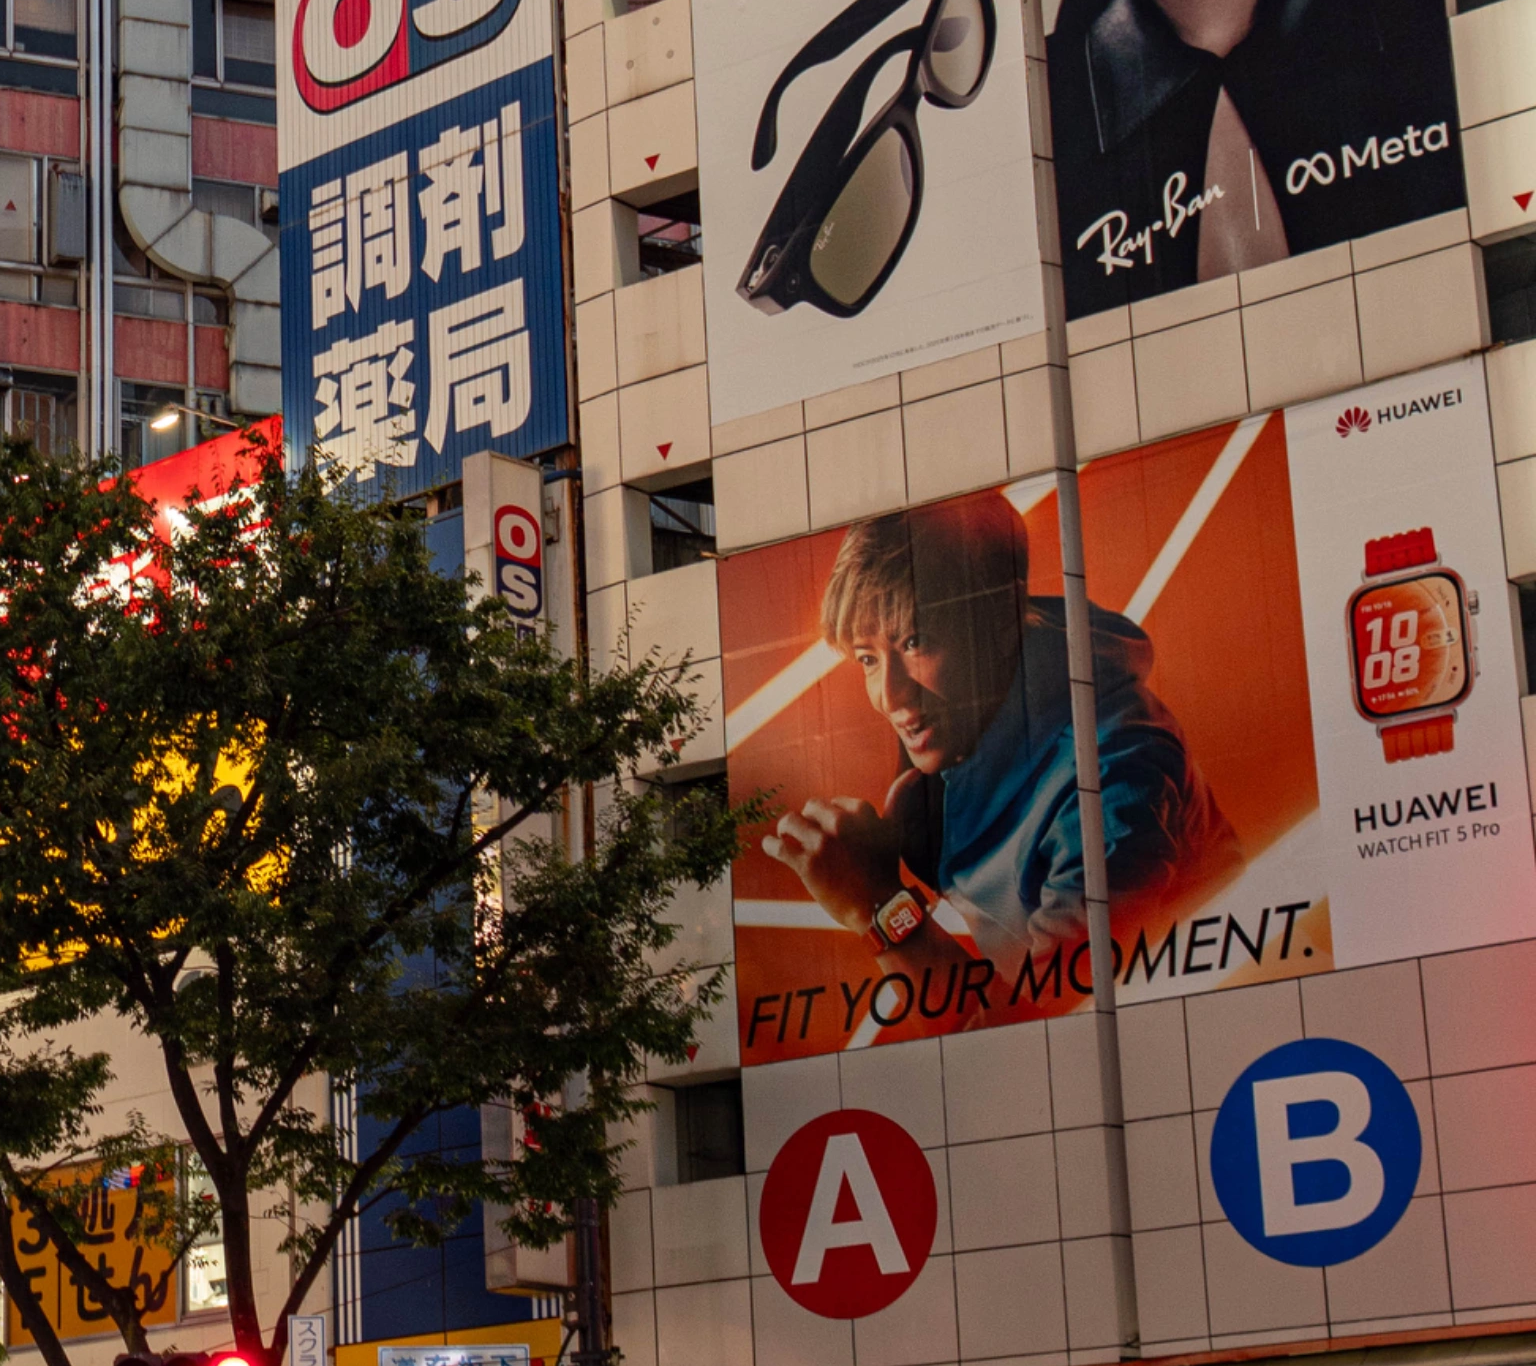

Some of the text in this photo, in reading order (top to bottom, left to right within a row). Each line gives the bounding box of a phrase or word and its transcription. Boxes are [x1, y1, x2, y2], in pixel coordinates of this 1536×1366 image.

[1340, 120, 1450, 179] Meta
[308, 101, 529, 331] 調剤
[310, 277, 532, 497] 薬局
[1376, 387, 1463, 425] HUAWEI
[497, 512, 539, 617] OS
[1363, 644, 1421, 689] 08
[1365, 609, 1419, 654] 10
[1353, 781, 1499, 834] HUAWEI
[1357, 821, 1501, 860] WATCH FIT 5 Pro
[745, 899, 1315, 1050] FIT YOUR MOMENT.
[1252, 1070, 1386, 1238] B
[791, 1131, 911, 1287] A
